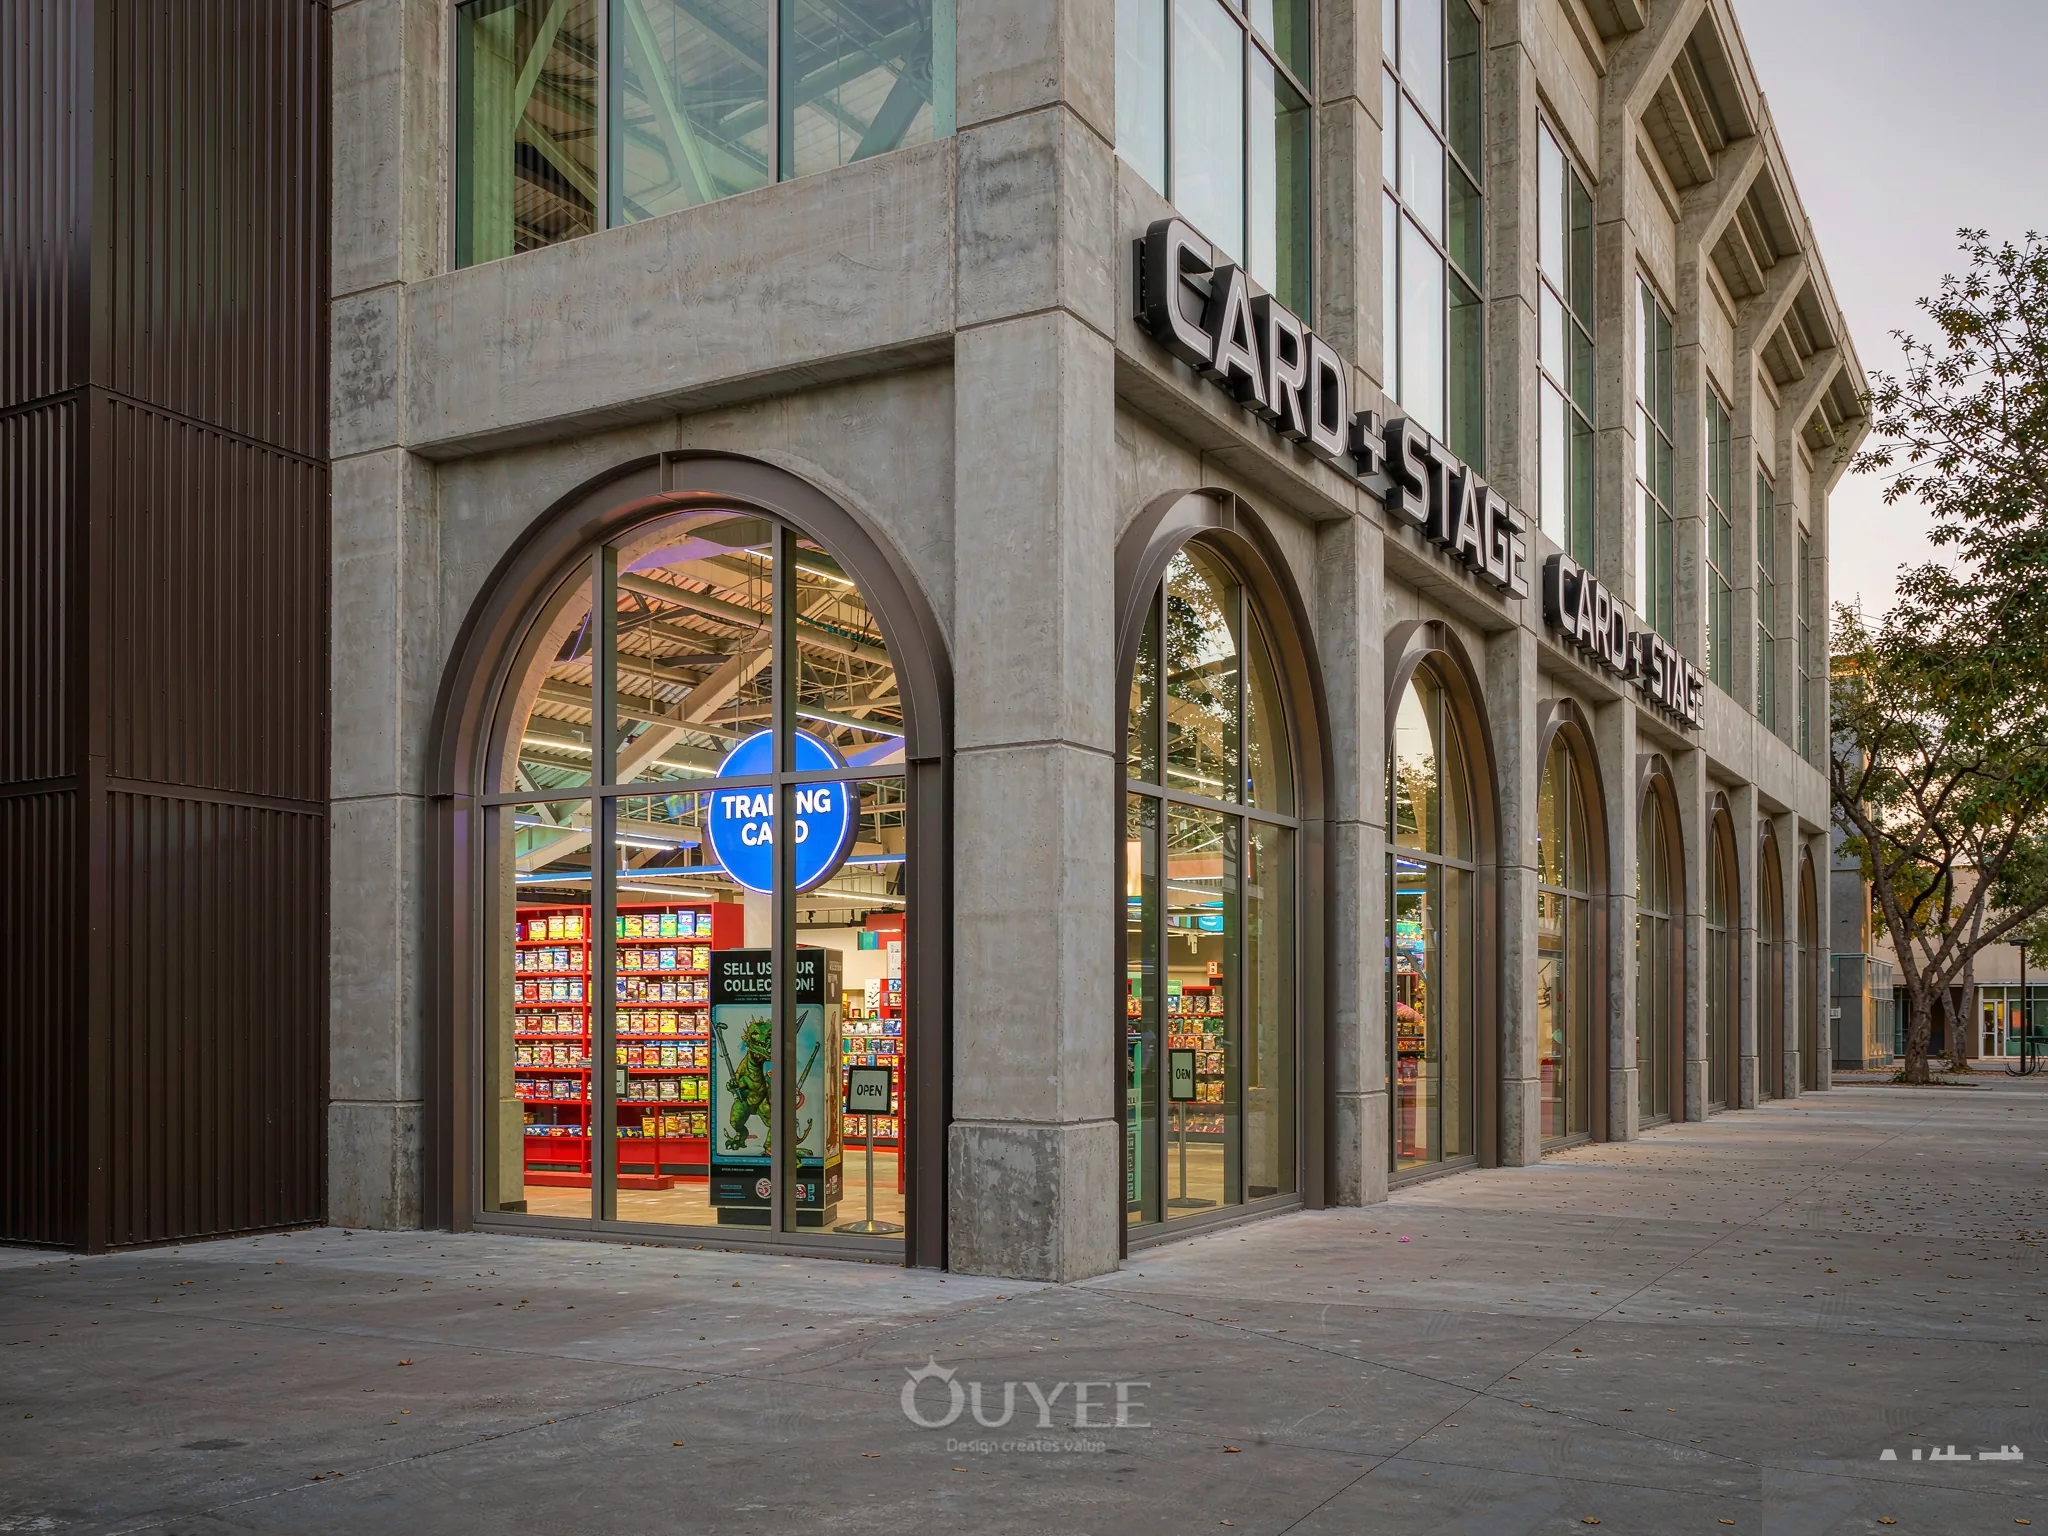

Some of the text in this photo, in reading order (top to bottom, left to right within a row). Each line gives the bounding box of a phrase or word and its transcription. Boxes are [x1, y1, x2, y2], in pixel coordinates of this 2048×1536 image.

[1148, 217, 1348, 458] CARD
[1390, 417, 1529, 600] STAGE
[1550, 553, 1628, 674] CARD
[1646, 633, 1705, 731] STAGE
[741, 819, 809, 846] CAD
[723, 962, 754, 976] SELL
[757, 961, 772, 975] US
[723, 977, 815, 992] COLLECON!
[856, 1084, 883, 1097] OPEN
